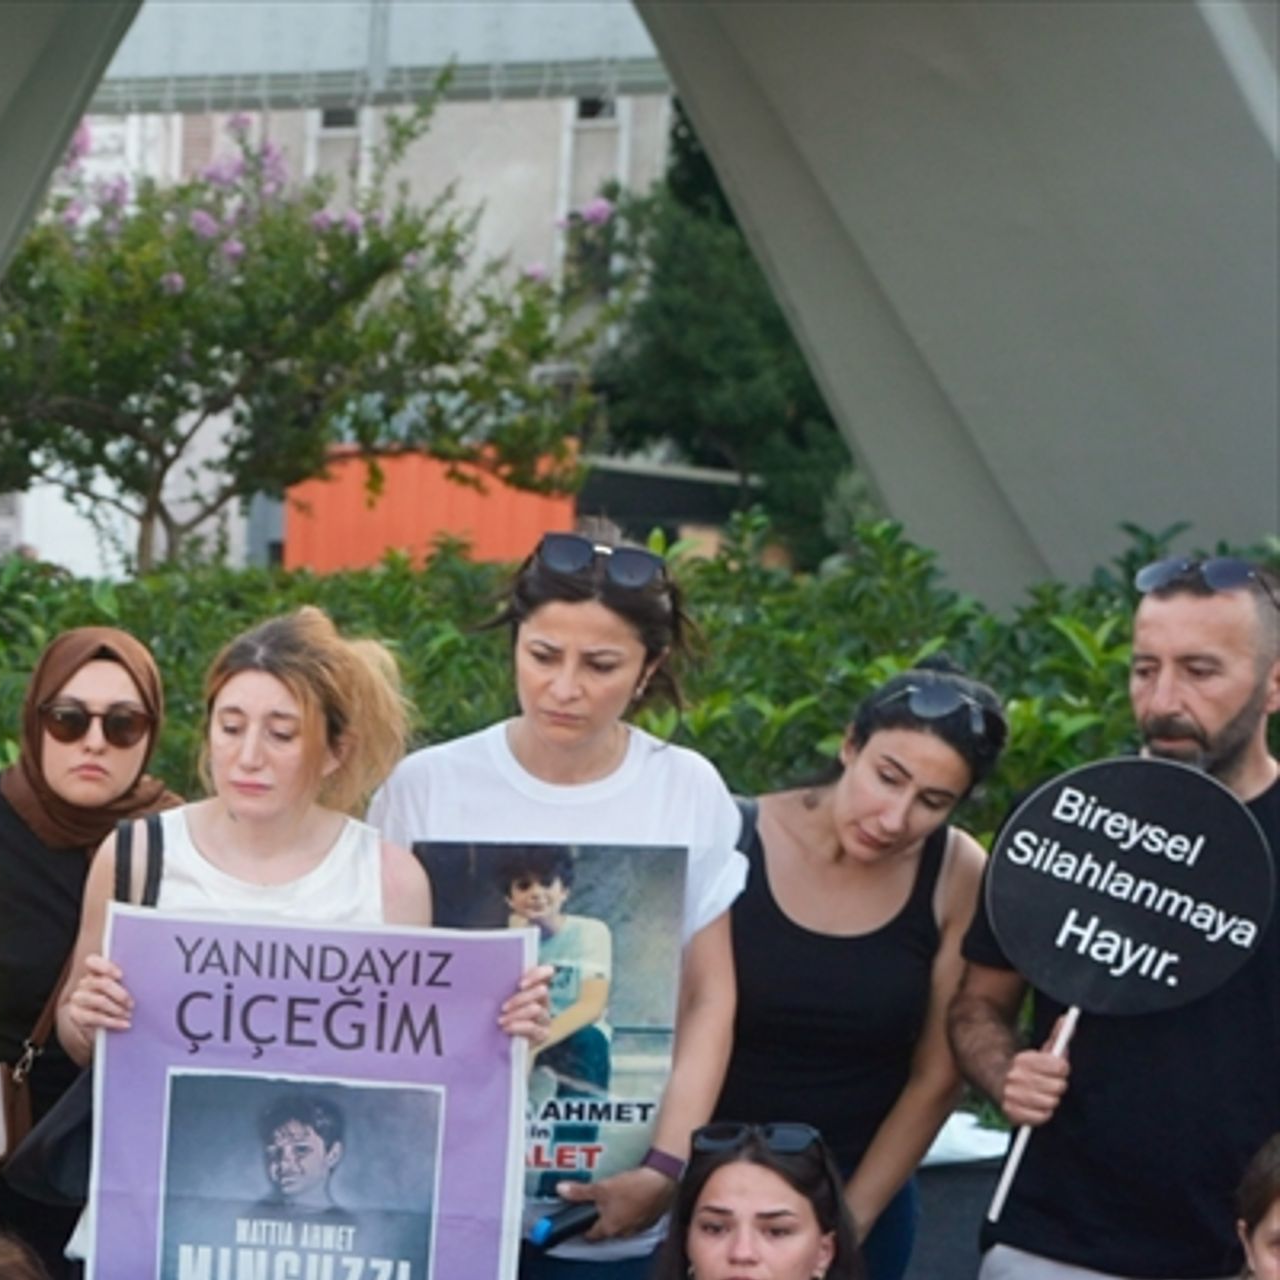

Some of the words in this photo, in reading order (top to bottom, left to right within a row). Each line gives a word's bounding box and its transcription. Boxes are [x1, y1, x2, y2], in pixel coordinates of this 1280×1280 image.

[1052, 786, 1204, 867] Bireysel
[1006, 830, 1258, 948] Silahlanmaya
[174, 936, 454, 988] YANINDAYIZ
[1055, 908, 1180, 987] Hayır.
[175, 979, 445, 1059] ÇİÇEĞİM
[541, 1101, 656, 1123] AHMET
[526, 1146, 603, 1169] LET
[235, 1218, 294, 1247] MATTIA
[300, 1222, 356, 1250] AHMET
